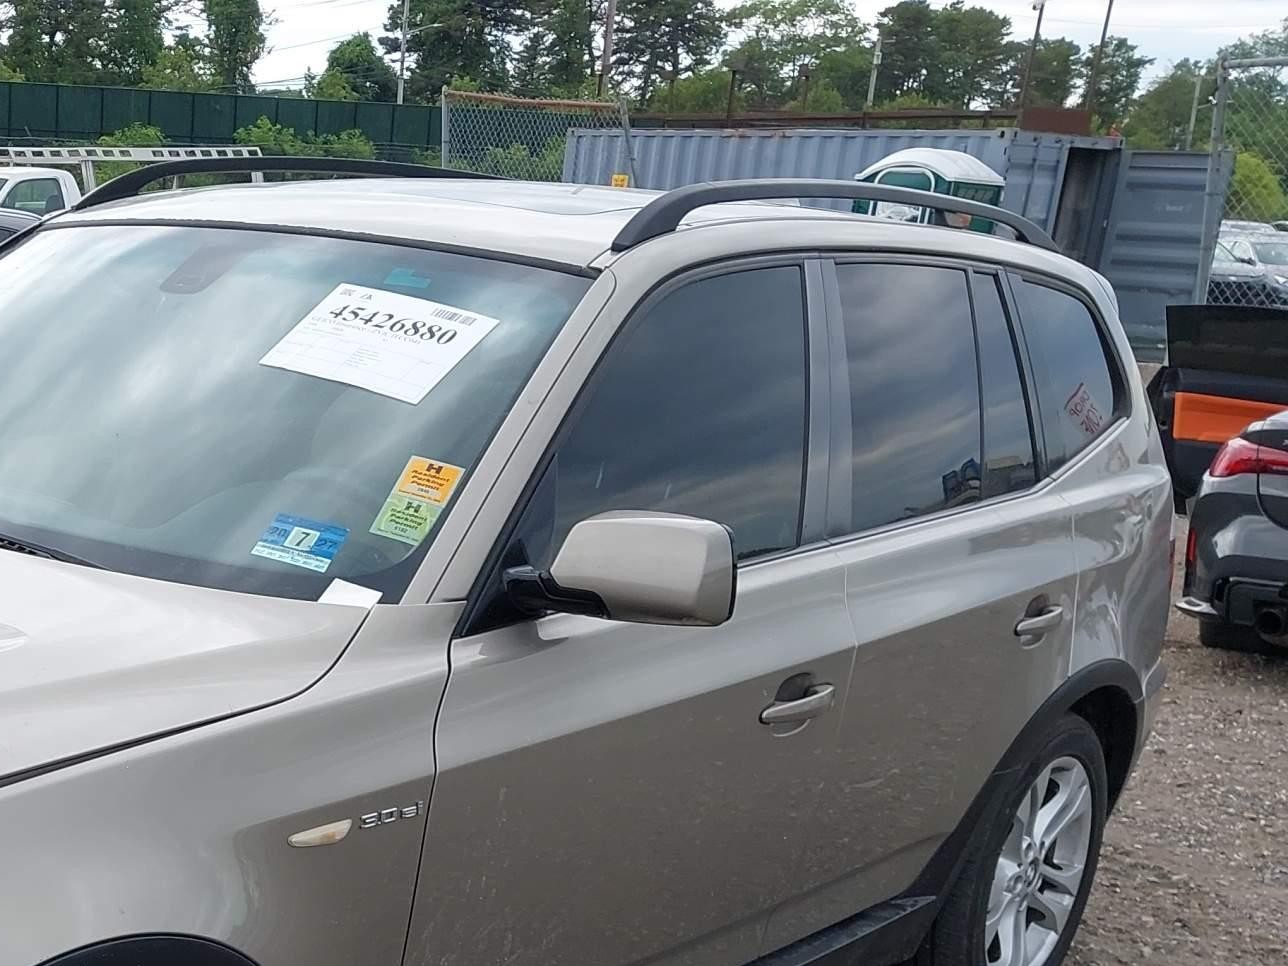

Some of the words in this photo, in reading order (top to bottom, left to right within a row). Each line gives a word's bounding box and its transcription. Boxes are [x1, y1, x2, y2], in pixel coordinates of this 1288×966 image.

[329, 304, 458, 345] 45426880
[425, 463, 444, 475] H
[411, 475, 446, 488] Parking
[404, 501, 423, 513] H
[295, 531, 312, 547] 7
